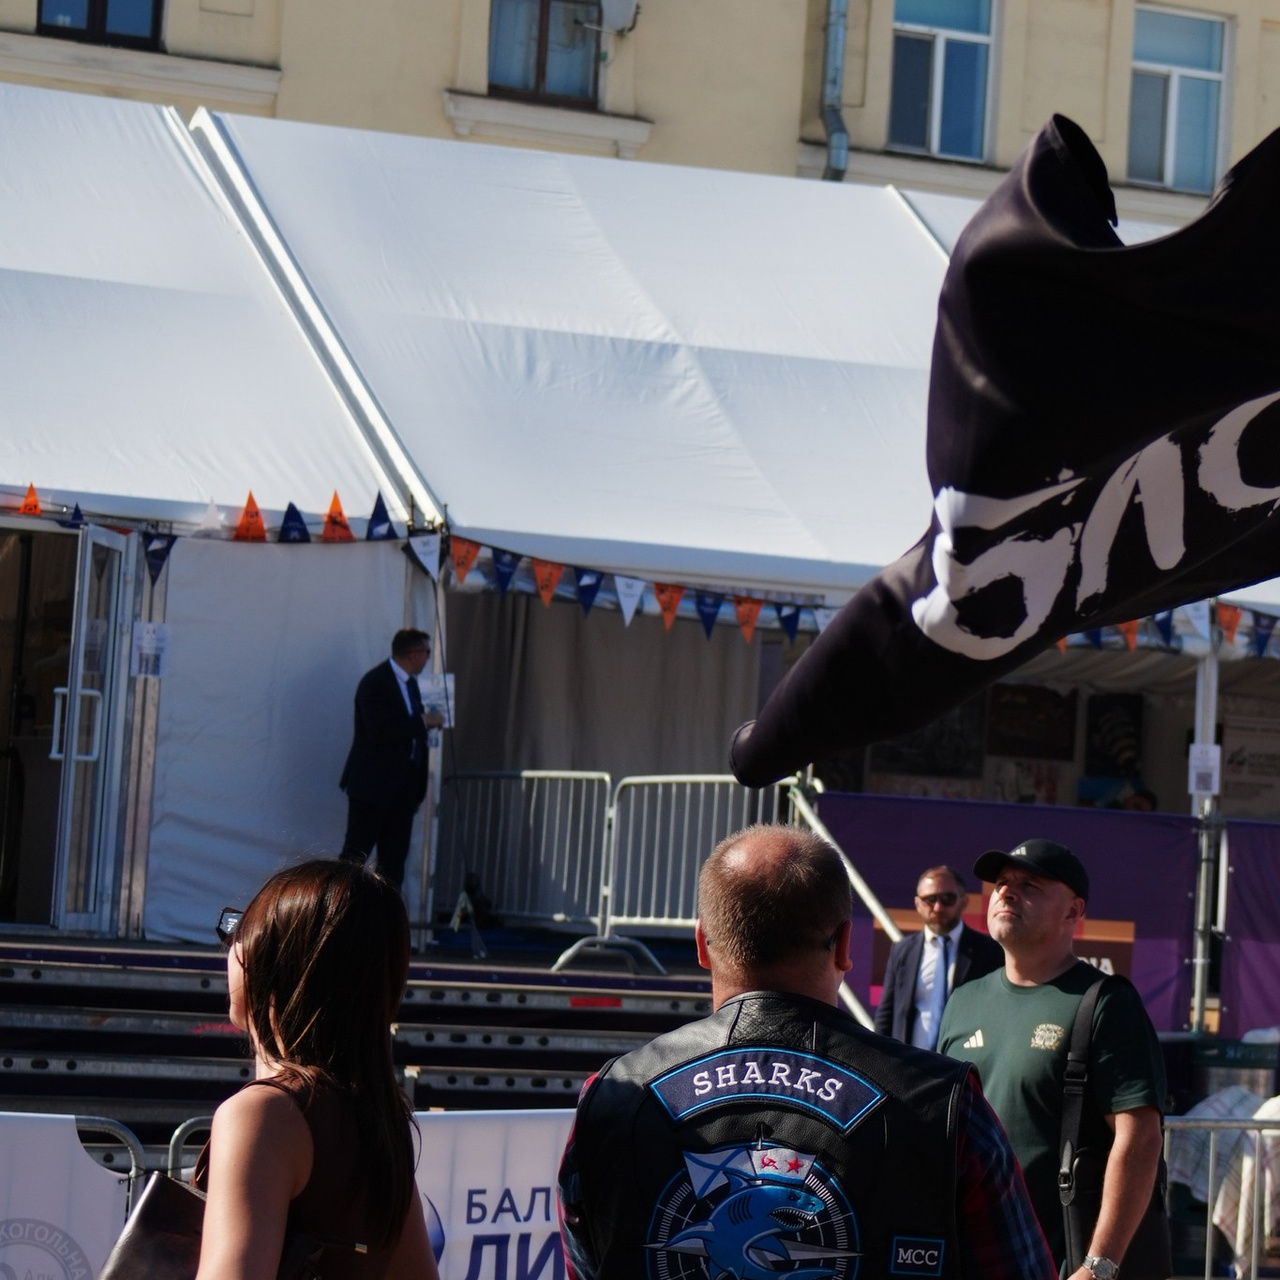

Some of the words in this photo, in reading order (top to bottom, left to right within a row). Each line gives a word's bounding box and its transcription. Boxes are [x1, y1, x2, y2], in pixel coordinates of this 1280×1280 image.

[693, 1061, 843, 1102] SHARKS
[466, 1186, 551, 1224] БАЛ
[897, 1248, 938, 1266] MCC
